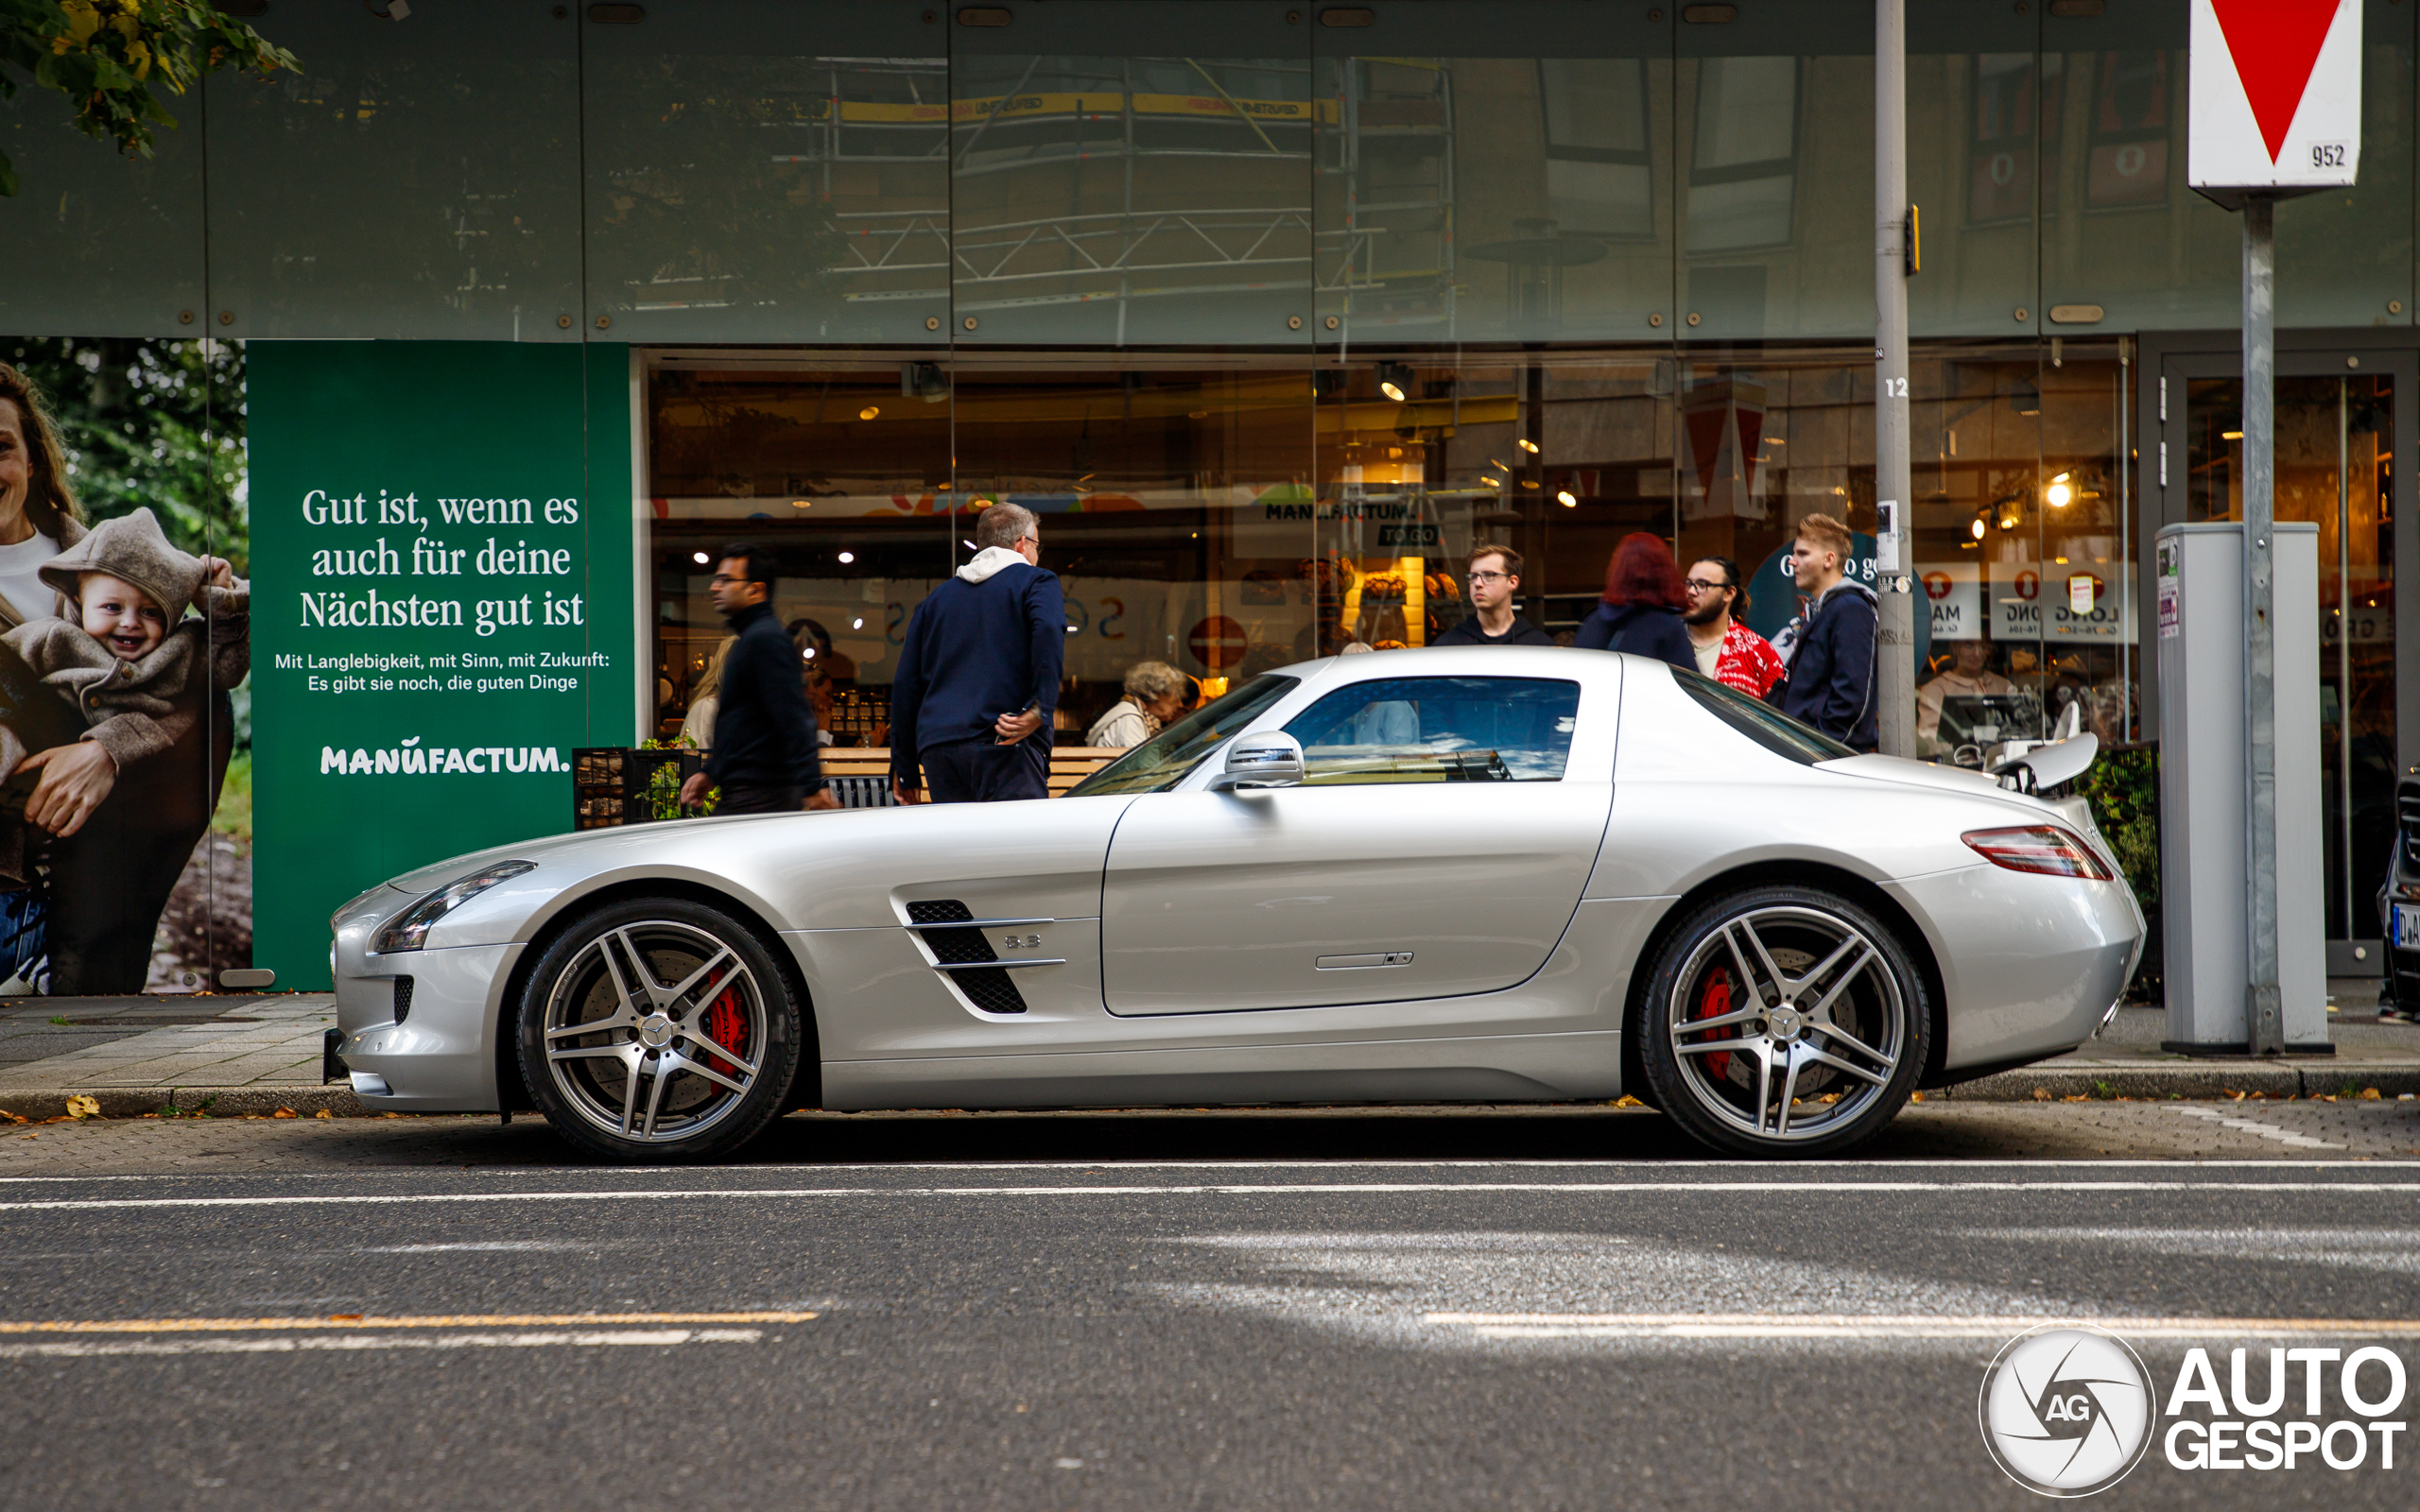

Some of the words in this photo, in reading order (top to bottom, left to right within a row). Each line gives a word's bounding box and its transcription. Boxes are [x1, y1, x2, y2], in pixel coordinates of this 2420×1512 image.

[2312, 145, 2345, 167] 952
[1885, 377, 1909, 398] 12
[302, 490, 367, 525] Gut
[379, 489, 428, 532] ist,
[438, 498, 533, 525] wenn
[544, 497, 579, 525] es
[1385, 529, 1407, 542] TO
[1409, 528, 1435, 542] GO
[312, 537, 402, 576] auch
[412, 536, 467, 576] für
[475, 537, 572, 576] deine
[300, 589, 463, 627] Nächsten
[475, 593, 533, 637] gut
[543, 591, 584, 626] ist
[275, 653, 303, 669] Mit
[307, 652, 424, 671] Langlebigkeit,
[429, 653, 458, 669] mit
[461, 652, 504, 671] Sinn,
[508, 653, 536, 668] mit
[540, 652, 611, 668] Zukunft:
[308, 676, 329, 691] Es
[333, 675, 366, 695] gibt
[371, 676, 394, 691] sie
[399, 675, 443, 694] noch,
[447, 675, 472, 691] die
[476, 675, 525, 694] guten
[528, 674, 578, 692] Dinge
[1005, 934, 1041, 949] 6.3
